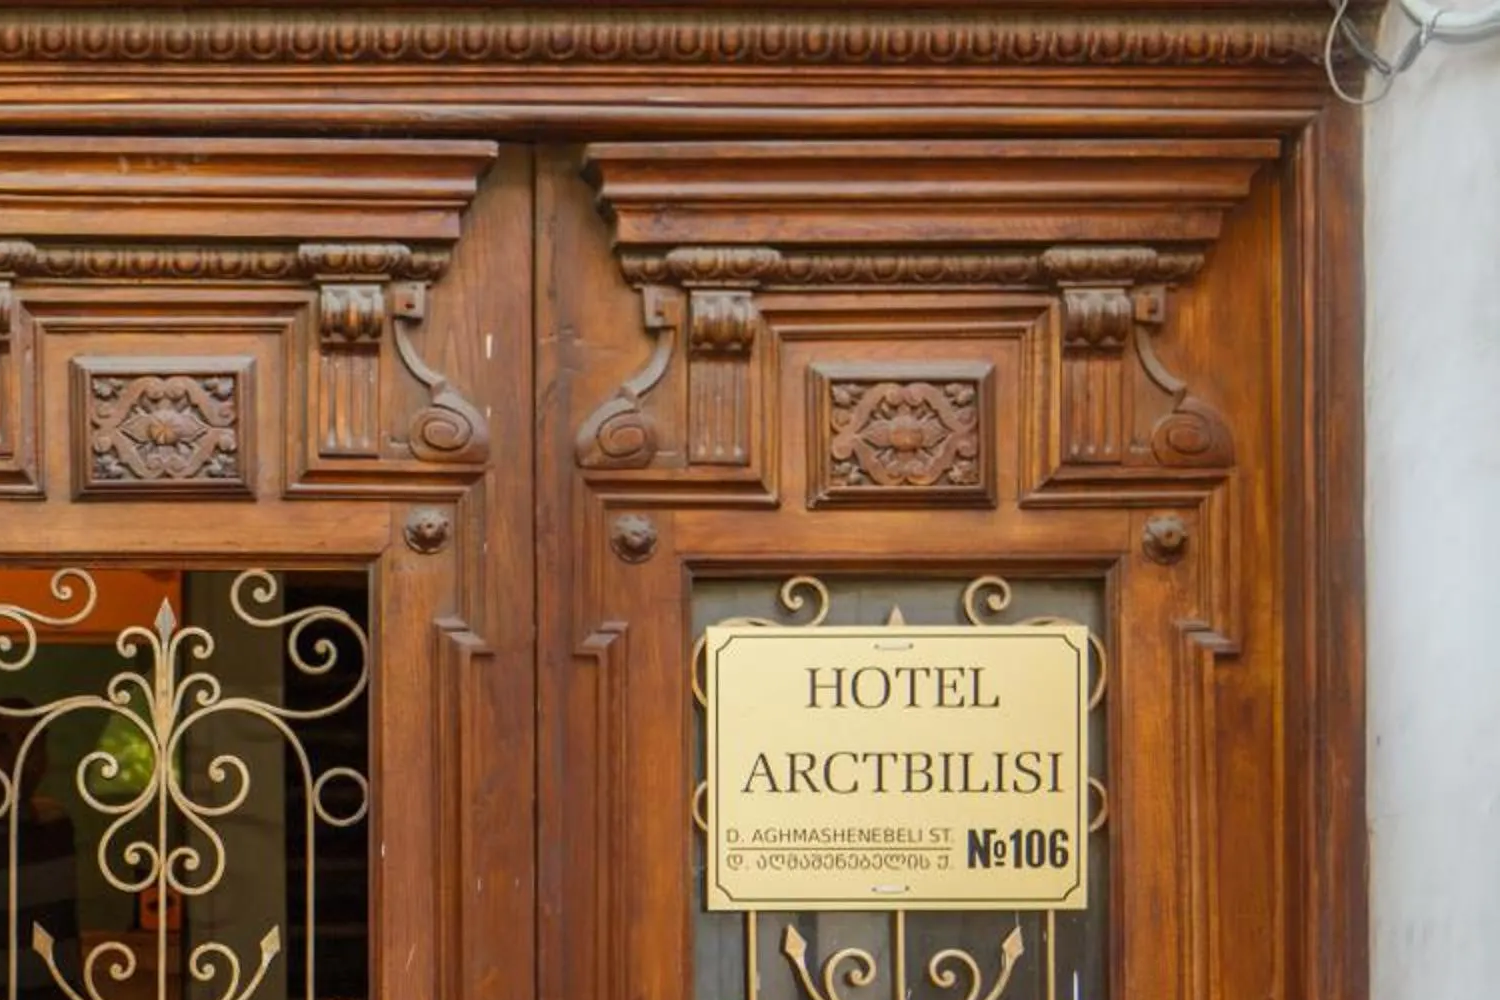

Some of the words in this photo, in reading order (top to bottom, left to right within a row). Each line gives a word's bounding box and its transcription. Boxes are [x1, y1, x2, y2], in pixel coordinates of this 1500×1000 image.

[804, 666, 1001, 709] HOTEL
[741, 751, 1065, 794] ARCTBILISI
[726, 829, 745, 844] D.
[752, 828, 923, 844] AGHMASHENEBELI
